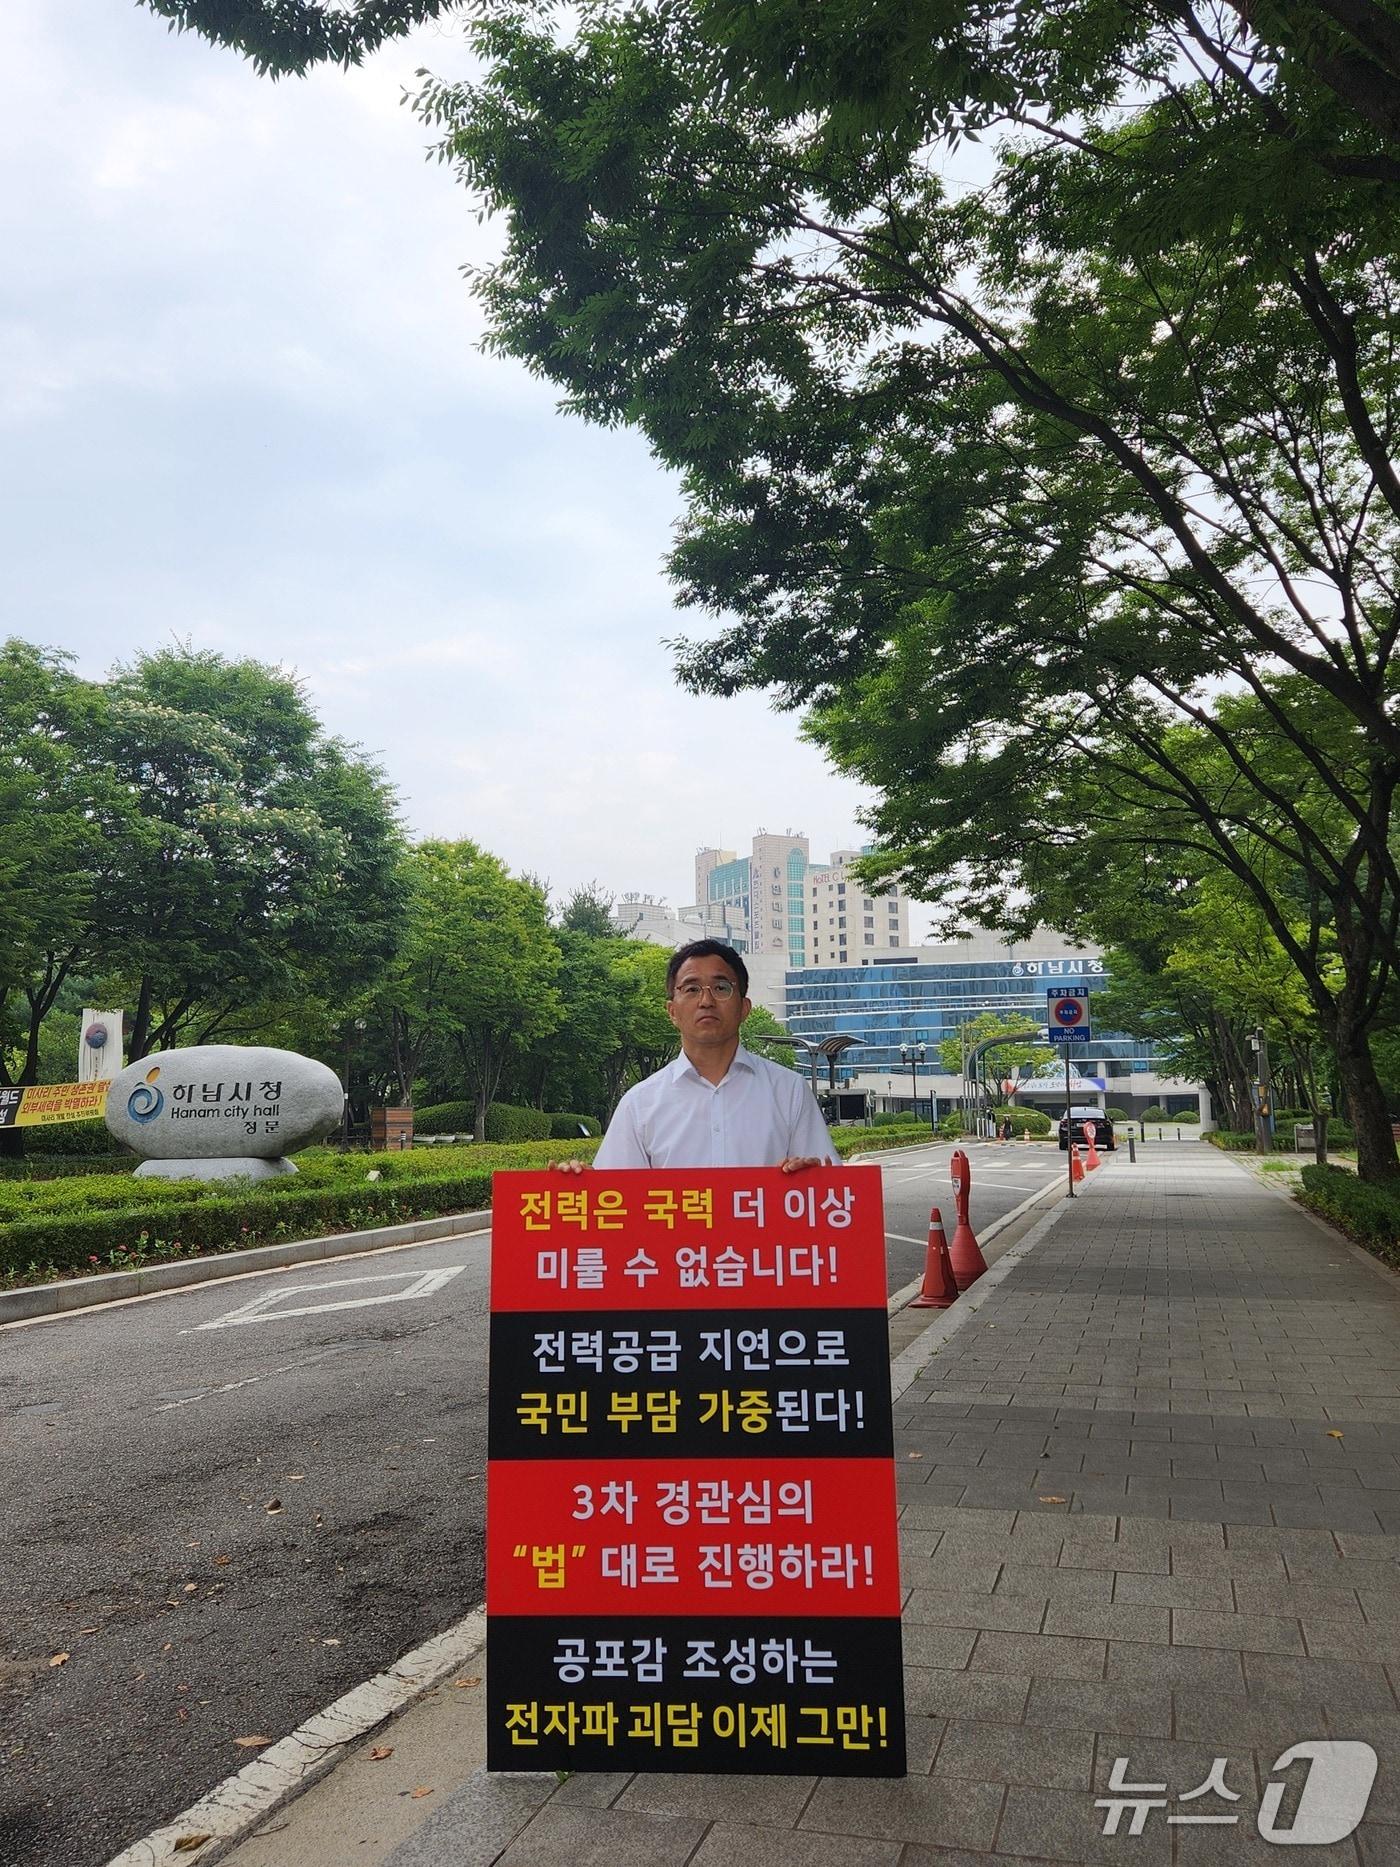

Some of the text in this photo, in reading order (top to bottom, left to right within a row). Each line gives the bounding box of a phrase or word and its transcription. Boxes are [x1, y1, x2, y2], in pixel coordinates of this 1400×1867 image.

[1026, 960, 1104, 975] 하남시청
[1051, 988, 1085, 997] 주차금지
[21, 1096, 102, 1114] 외부세력을 박멸하라!
[27, 1087, 52, 1099] 미사리
[53, 1085, 71, 1098] 주민
[71, 1082, 97, 1095] 생존권
[171, 1104, 280, 1119] Hanam city hall
[172, 1081, 282, 1103] 하남시청
[243, 1120, 280, 1135] 정문
[520, 1187, 856, 1231] 전력은 국력 더 이상
[537, 1245, 838, 1289] 미룰 수 없습니다!
[532, 1329, 849, 1374] 전력공급 지연으로
[517, 1388, 864, 1435] 국민 부담 가중된다!
[572, 1479, 813, 1526] 3차 경관심의
[602, 1543, 679, 1589] 대로
[698, 1543, 873, 1590] 진행하라!
[554, 1637, 838, 1685] 공포감 조성하는
[505, 1701, 888, 1750] 전자파 괴담 이제 그만!
